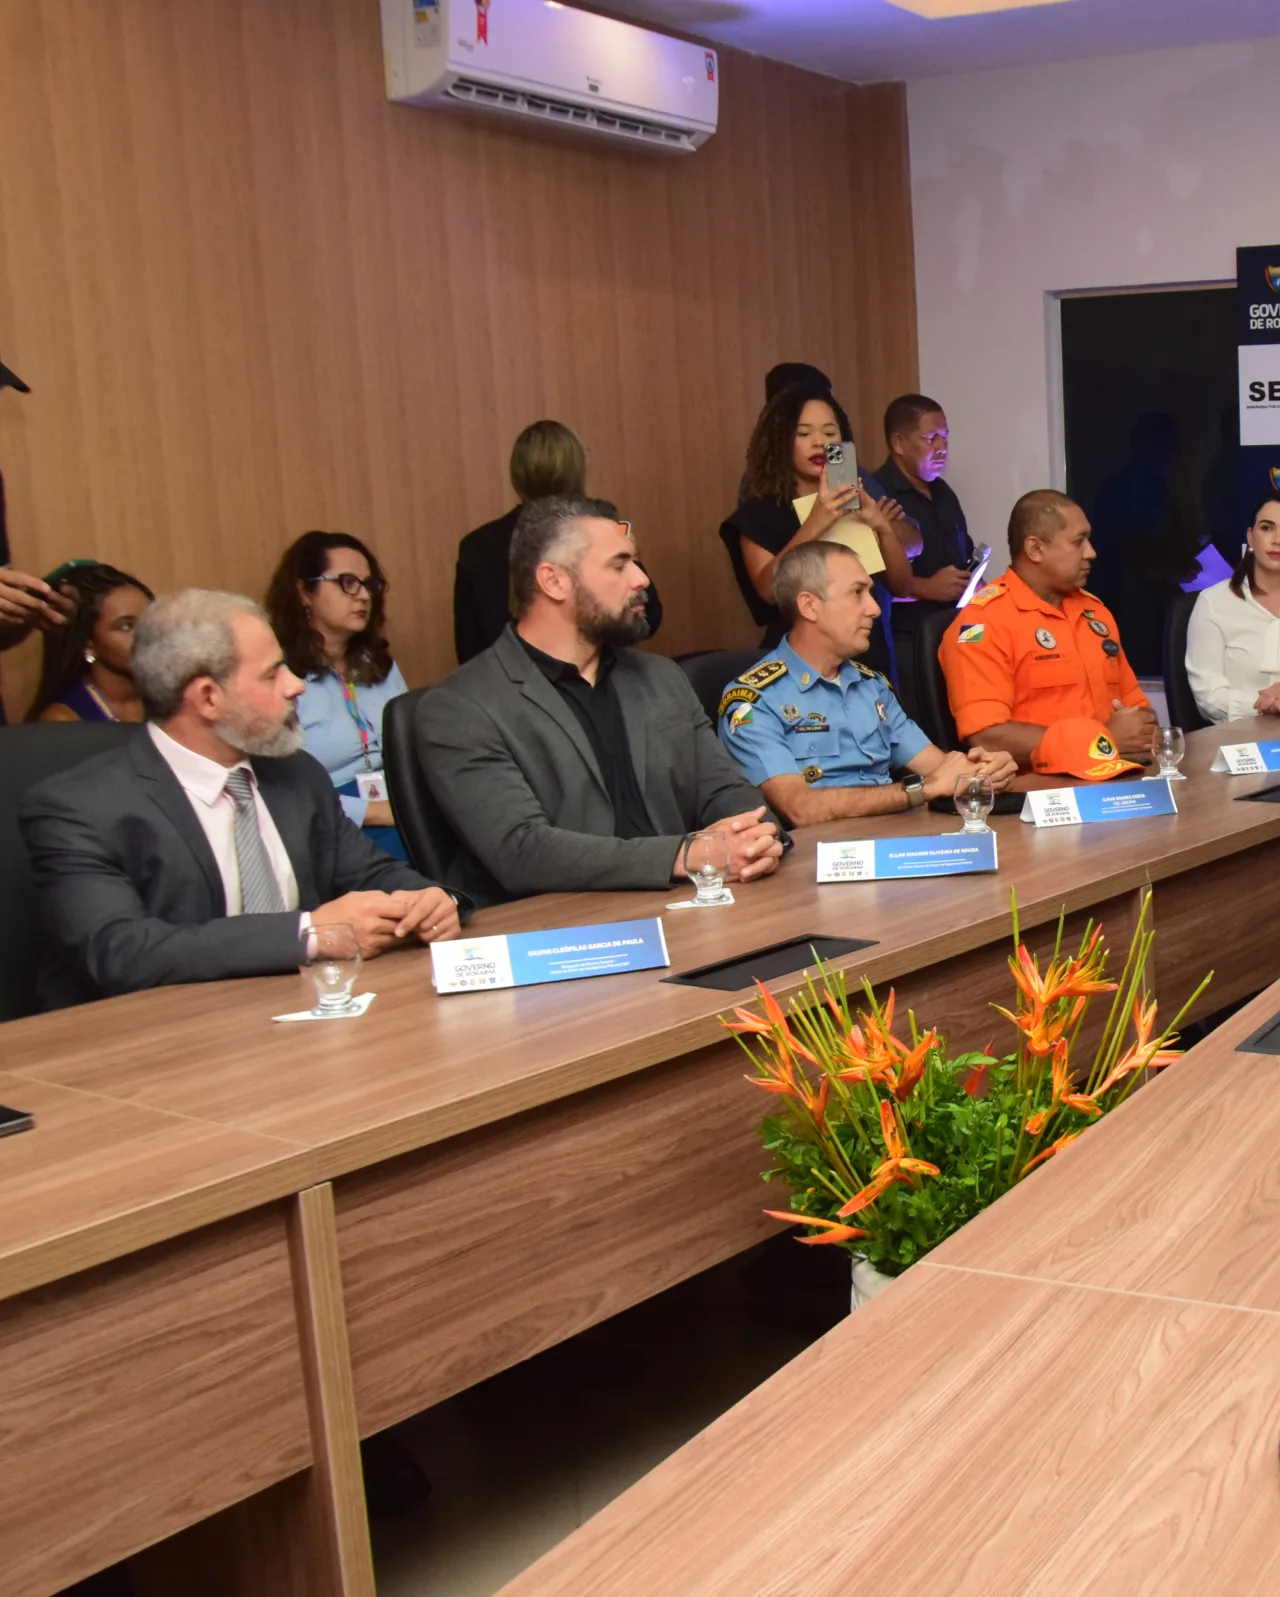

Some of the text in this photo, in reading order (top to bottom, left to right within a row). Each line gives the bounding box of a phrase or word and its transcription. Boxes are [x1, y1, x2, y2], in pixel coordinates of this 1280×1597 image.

[1249, 318, 1264, 329] DE
[588, 941, 612, 950] GARCIA
[612, 939, 622, 947] DE
[623, 938, 644, 946] PAULA
[455, 961, 496, 972] GOVERNO
[456, 970, 464, 978] DE
